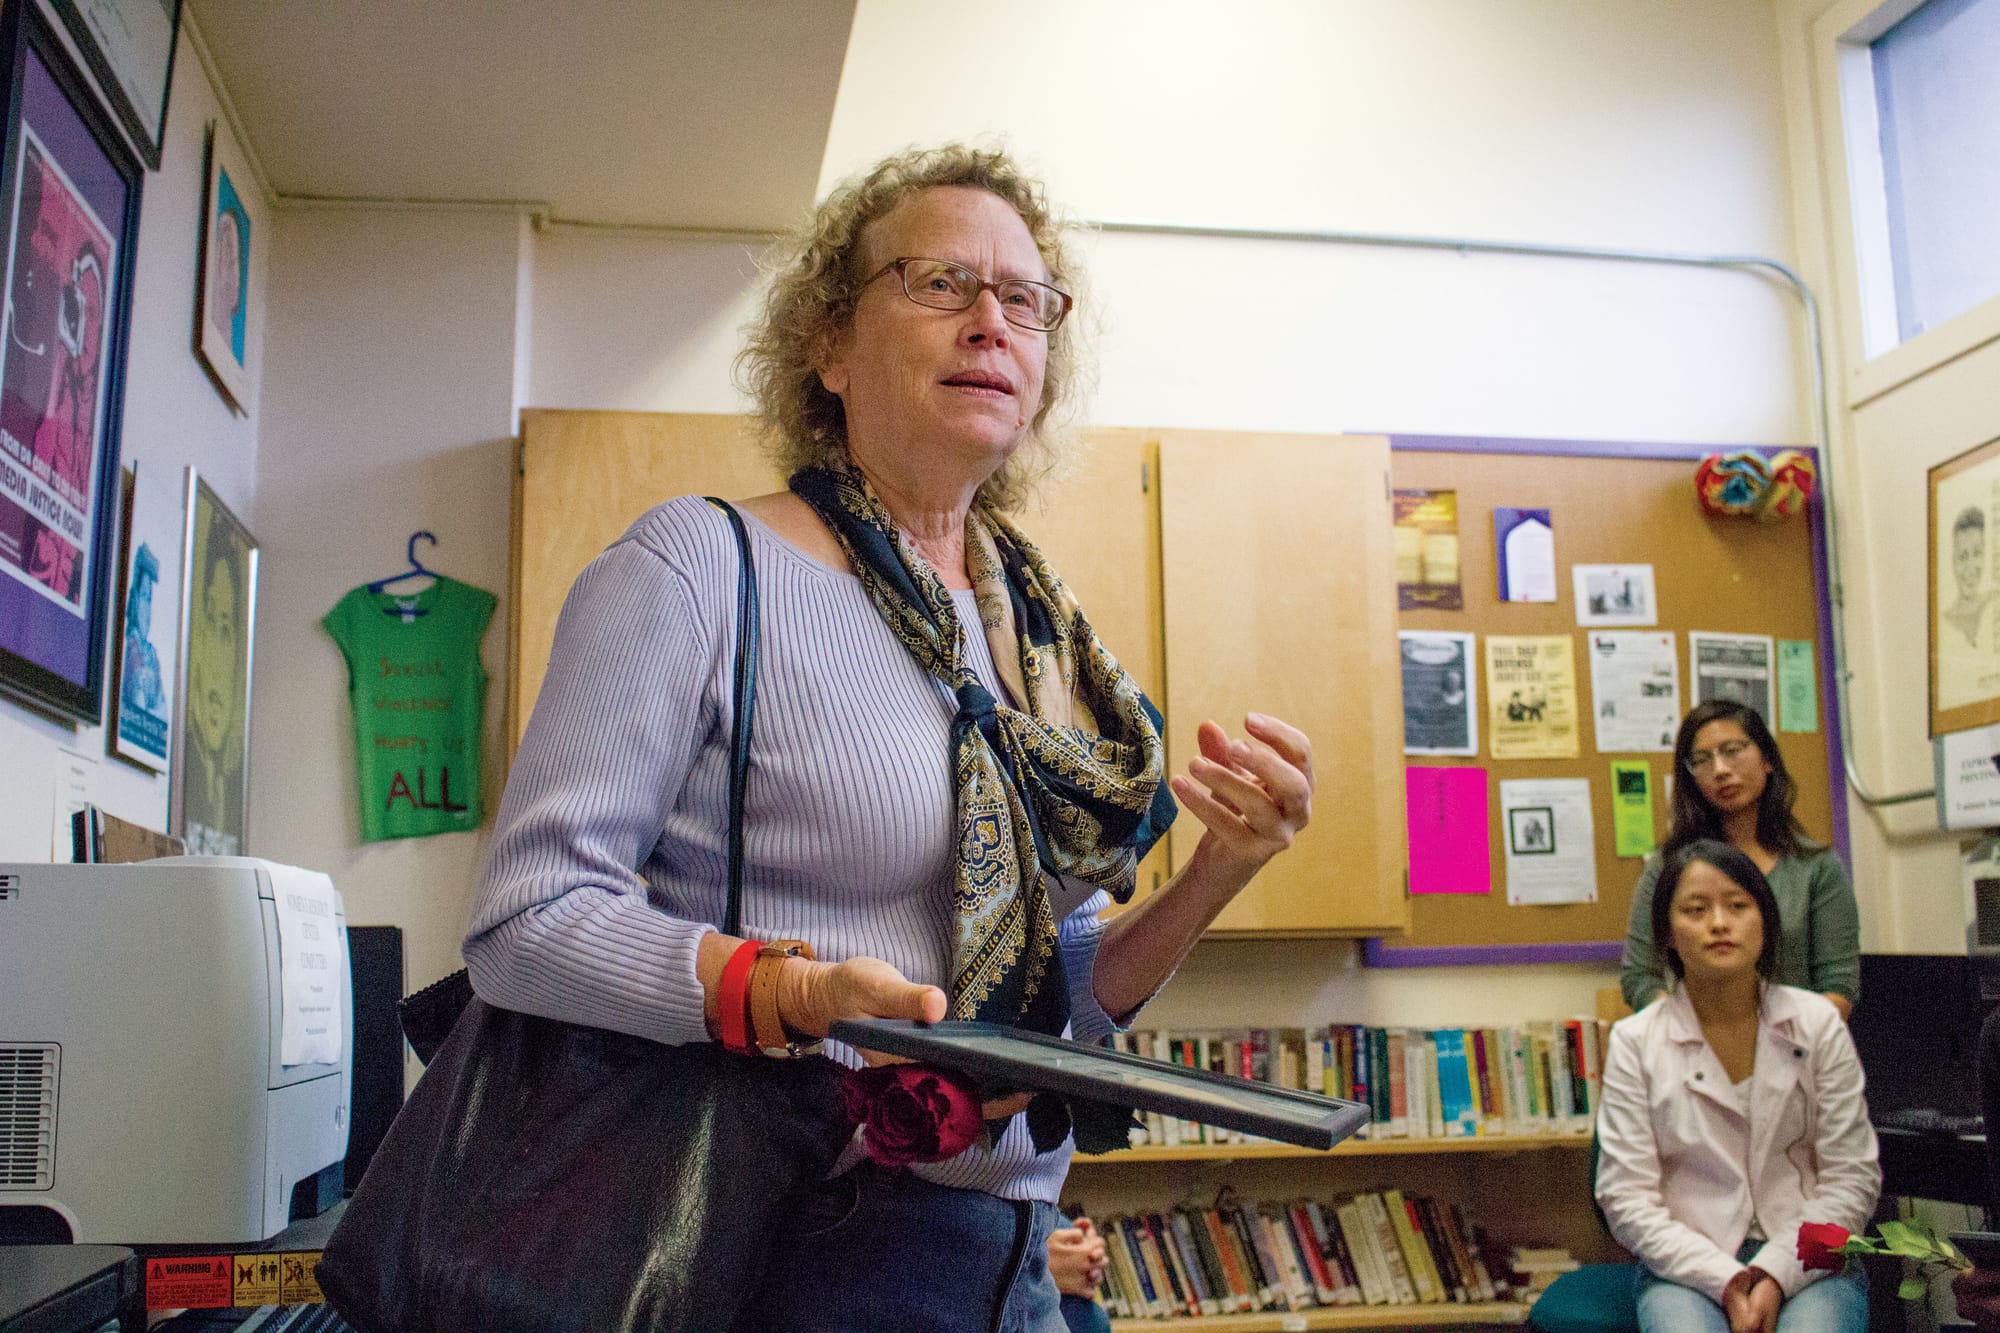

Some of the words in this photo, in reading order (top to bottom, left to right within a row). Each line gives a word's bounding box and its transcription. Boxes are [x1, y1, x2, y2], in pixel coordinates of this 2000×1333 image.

[29, 482, 61, 526] JUSTICE
[387, 766, 468, 812] ALL
[165, 1262, 211, 1275] WARNING
